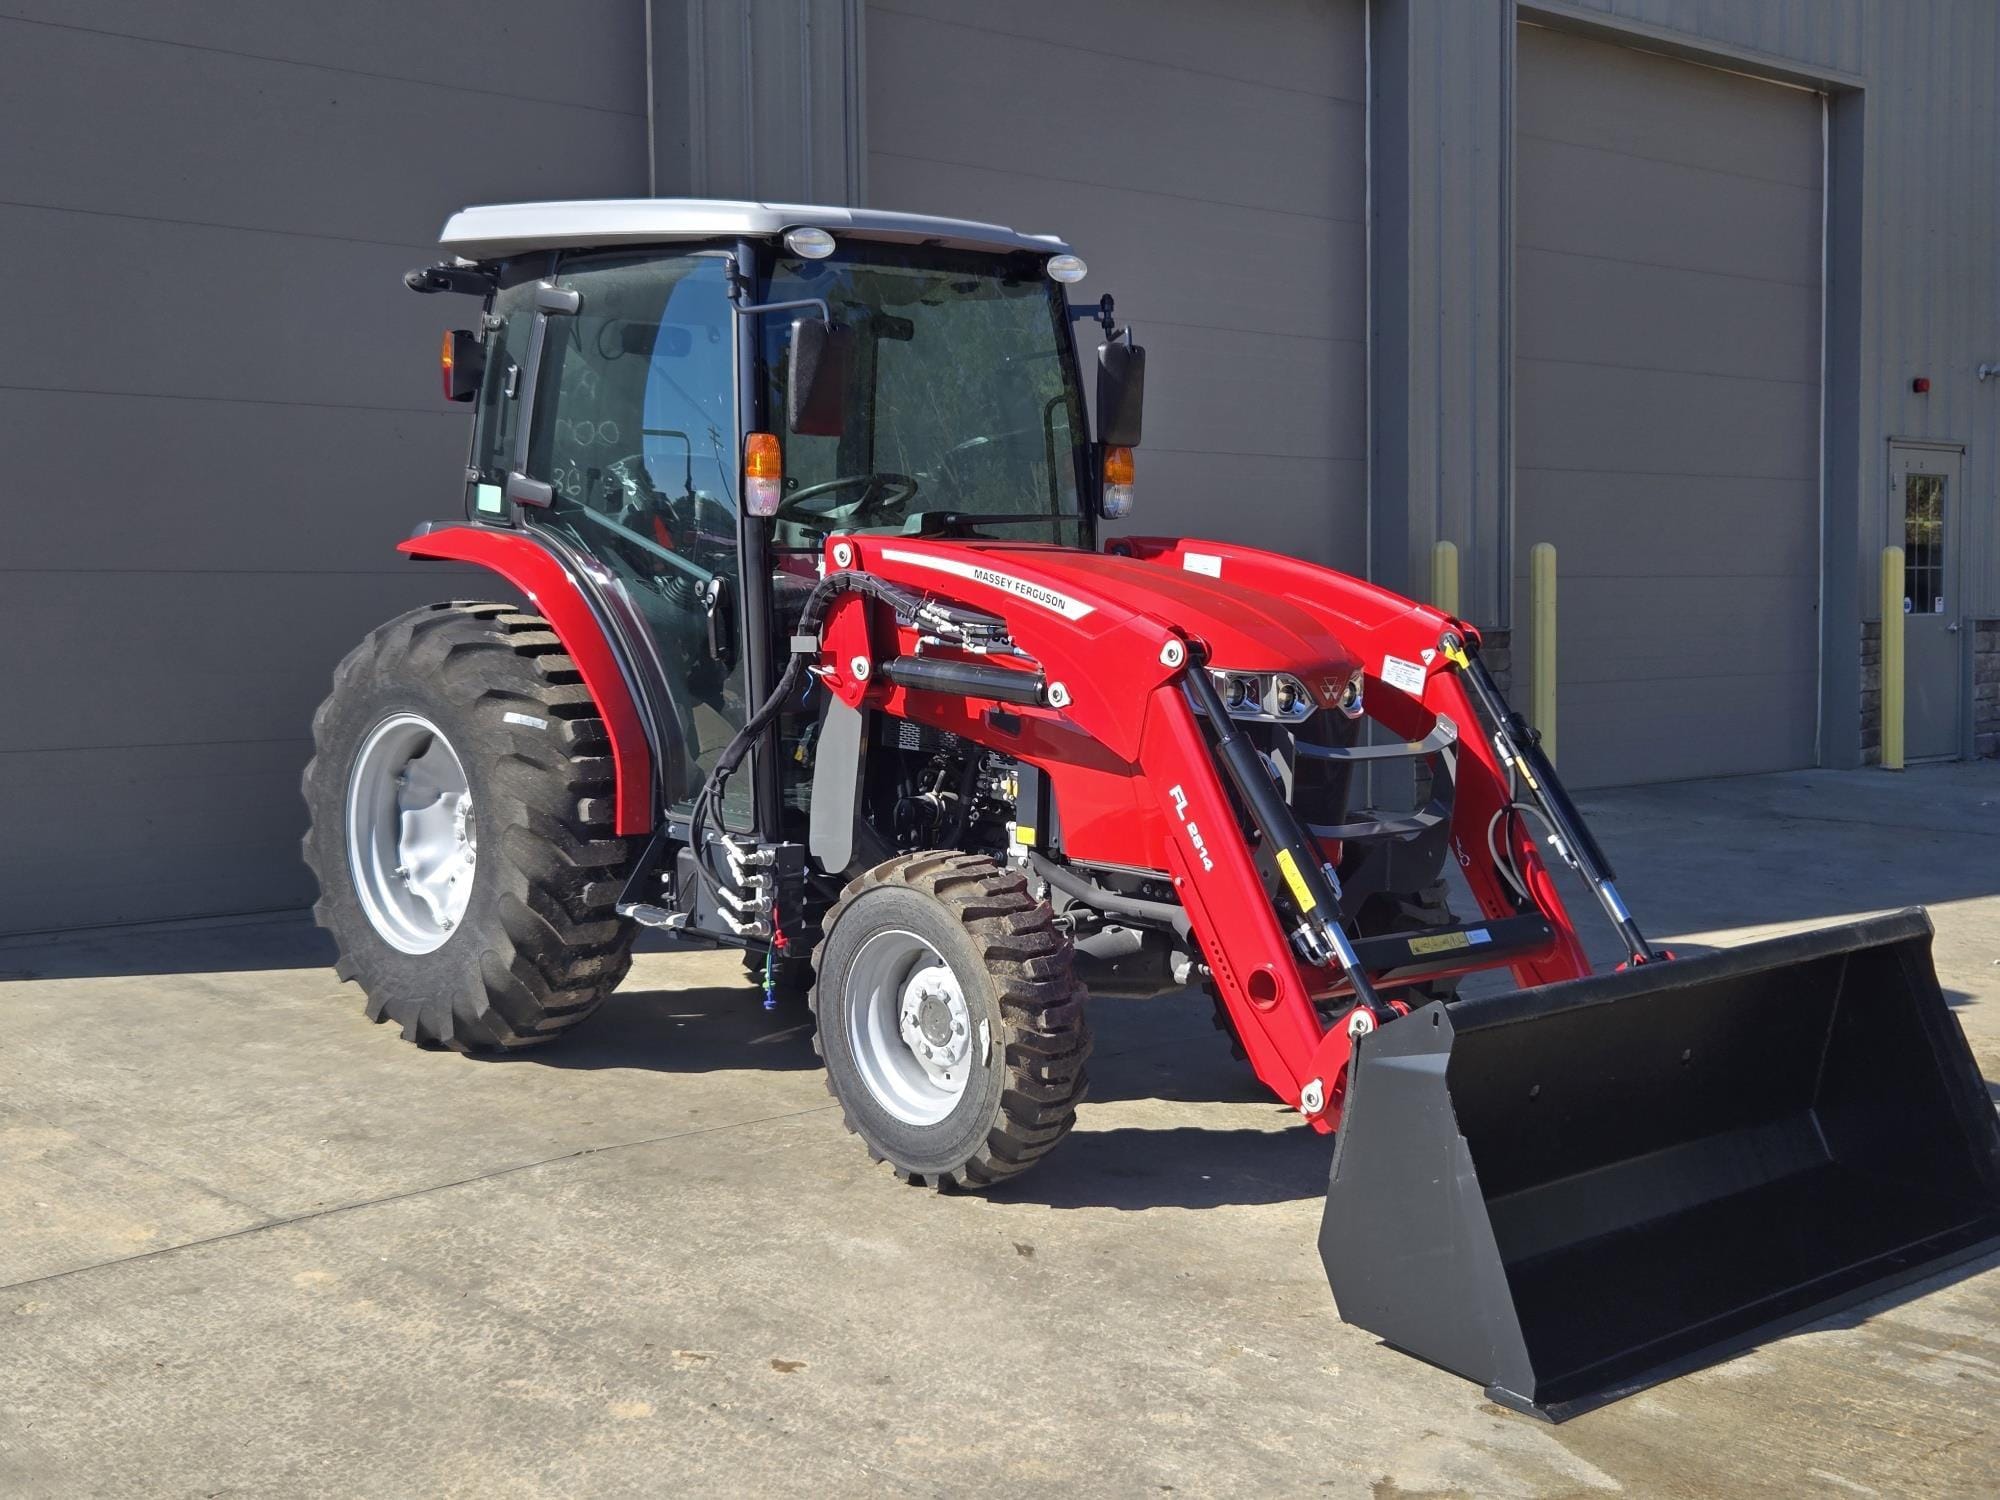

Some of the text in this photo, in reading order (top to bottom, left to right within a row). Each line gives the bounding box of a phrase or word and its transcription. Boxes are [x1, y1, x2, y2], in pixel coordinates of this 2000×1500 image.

[974, 569, 1066, 610] MASSEY FERGUSON
[1169, 784, 1213, 872] FL 2814
